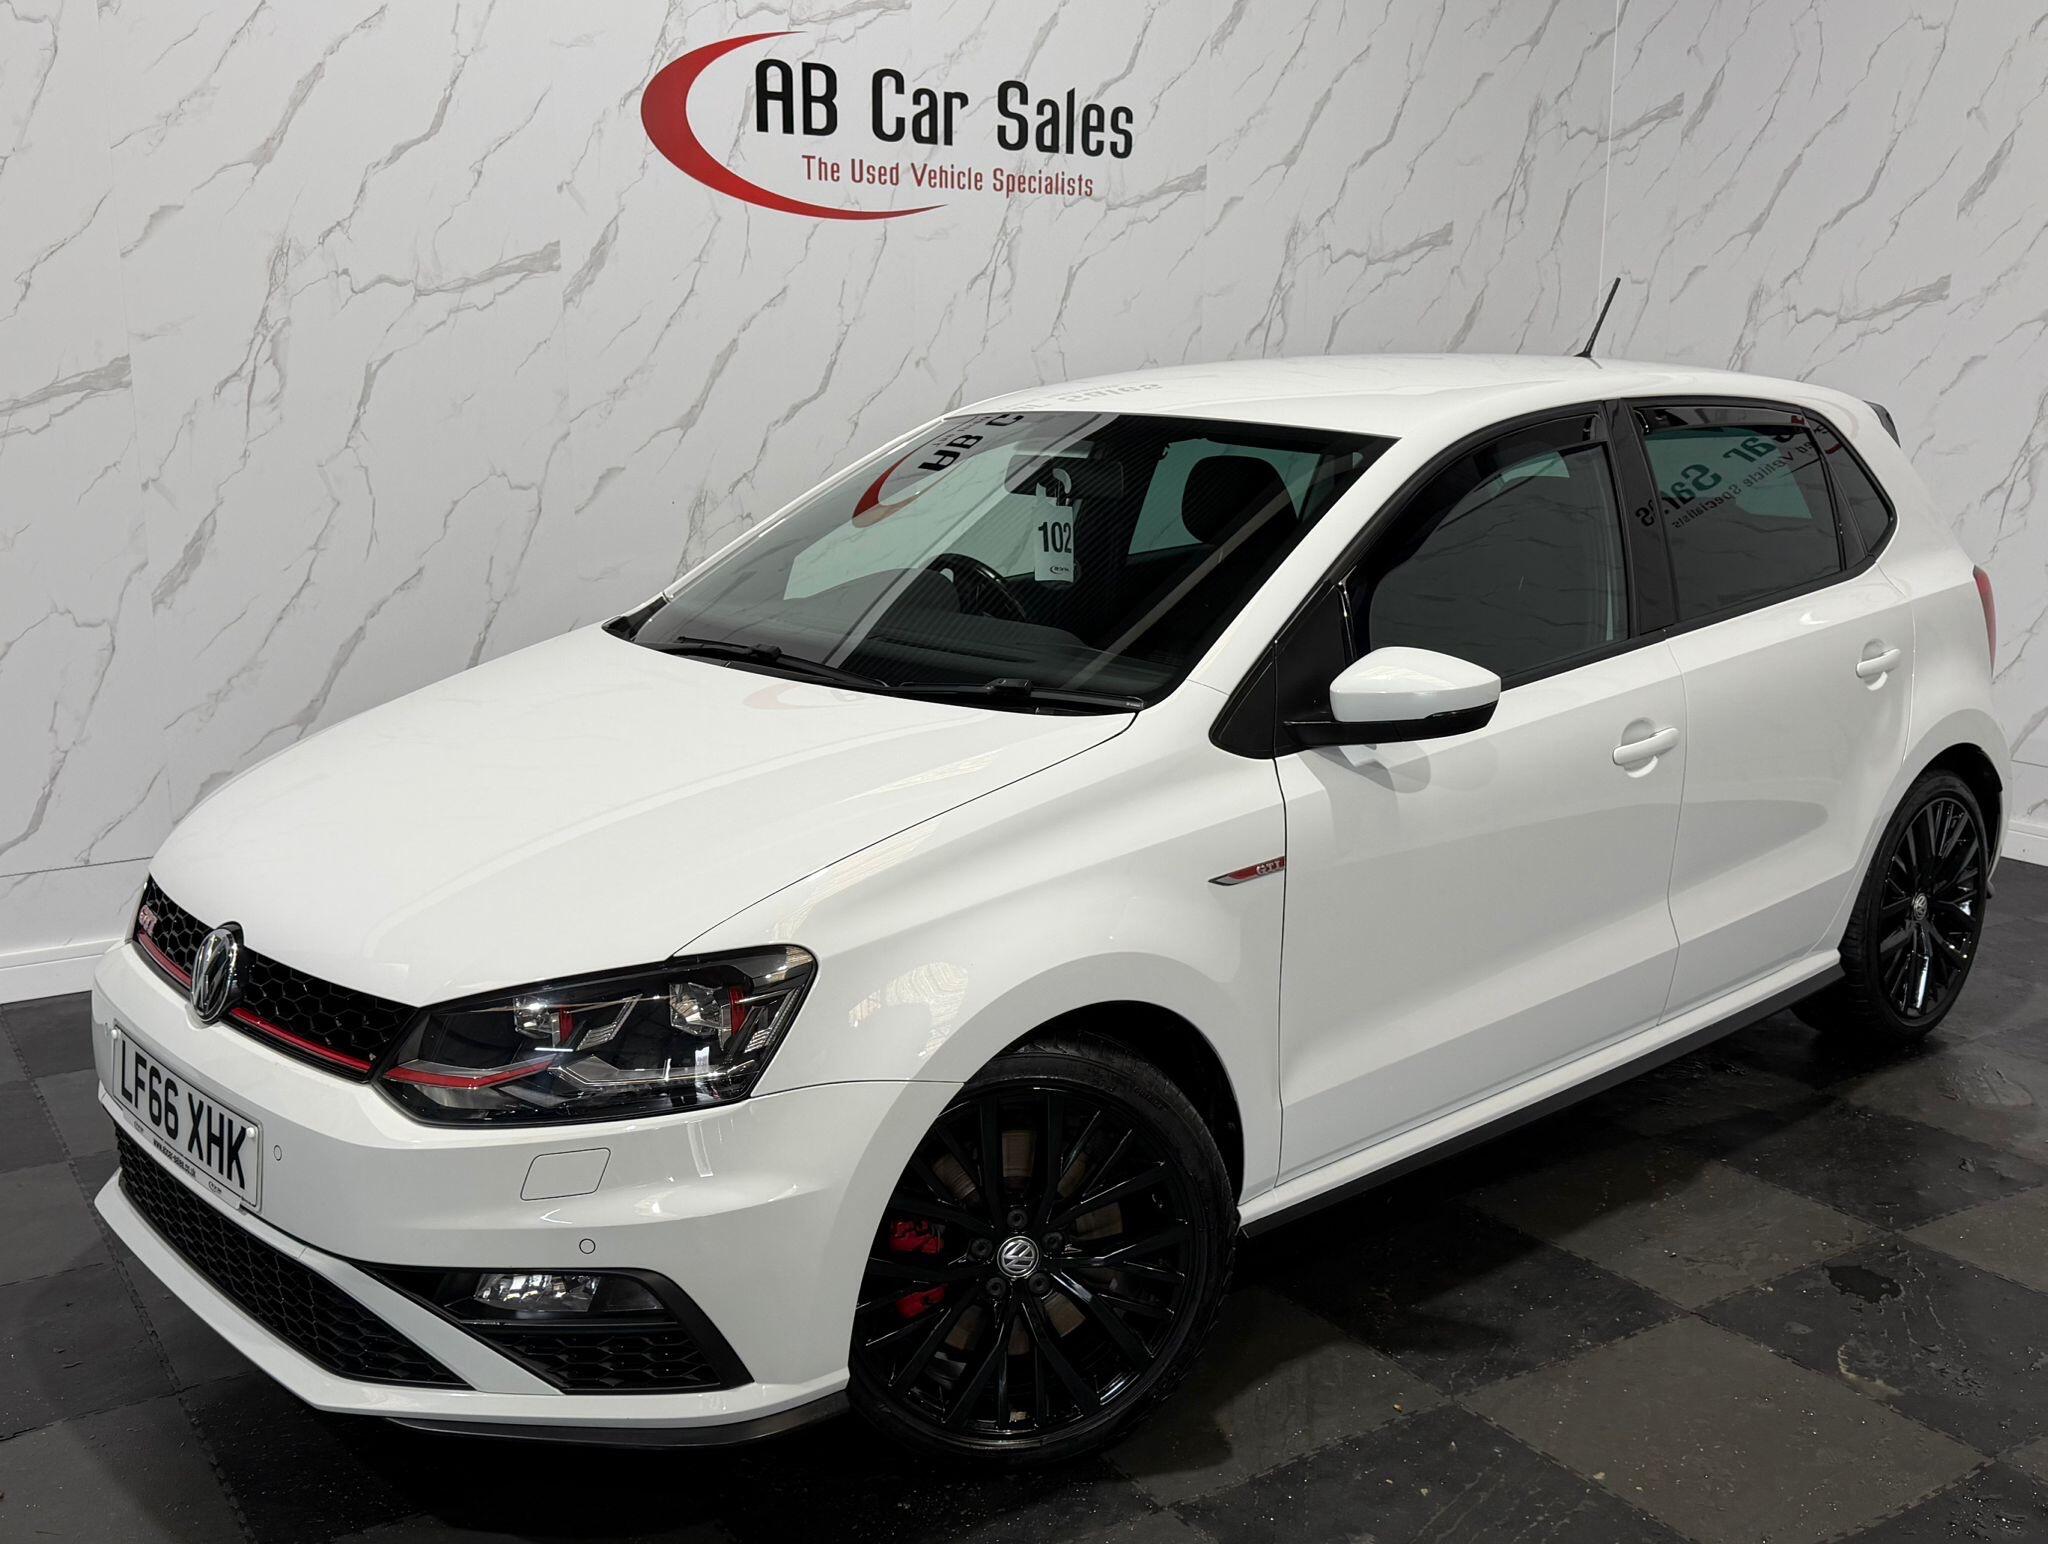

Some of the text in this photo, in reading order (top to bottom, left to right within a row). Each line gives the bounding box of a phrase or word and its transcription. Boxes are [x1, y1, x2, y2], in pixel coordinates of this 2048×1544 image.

[755, 58, 1134, 159] AB Car Sales
[802, 155, 1094, 197] The Used Vehicle Specialists
[1038, 522, 1072, 553] 102
[121, 1039, 247, 1190] LF66 XHK
